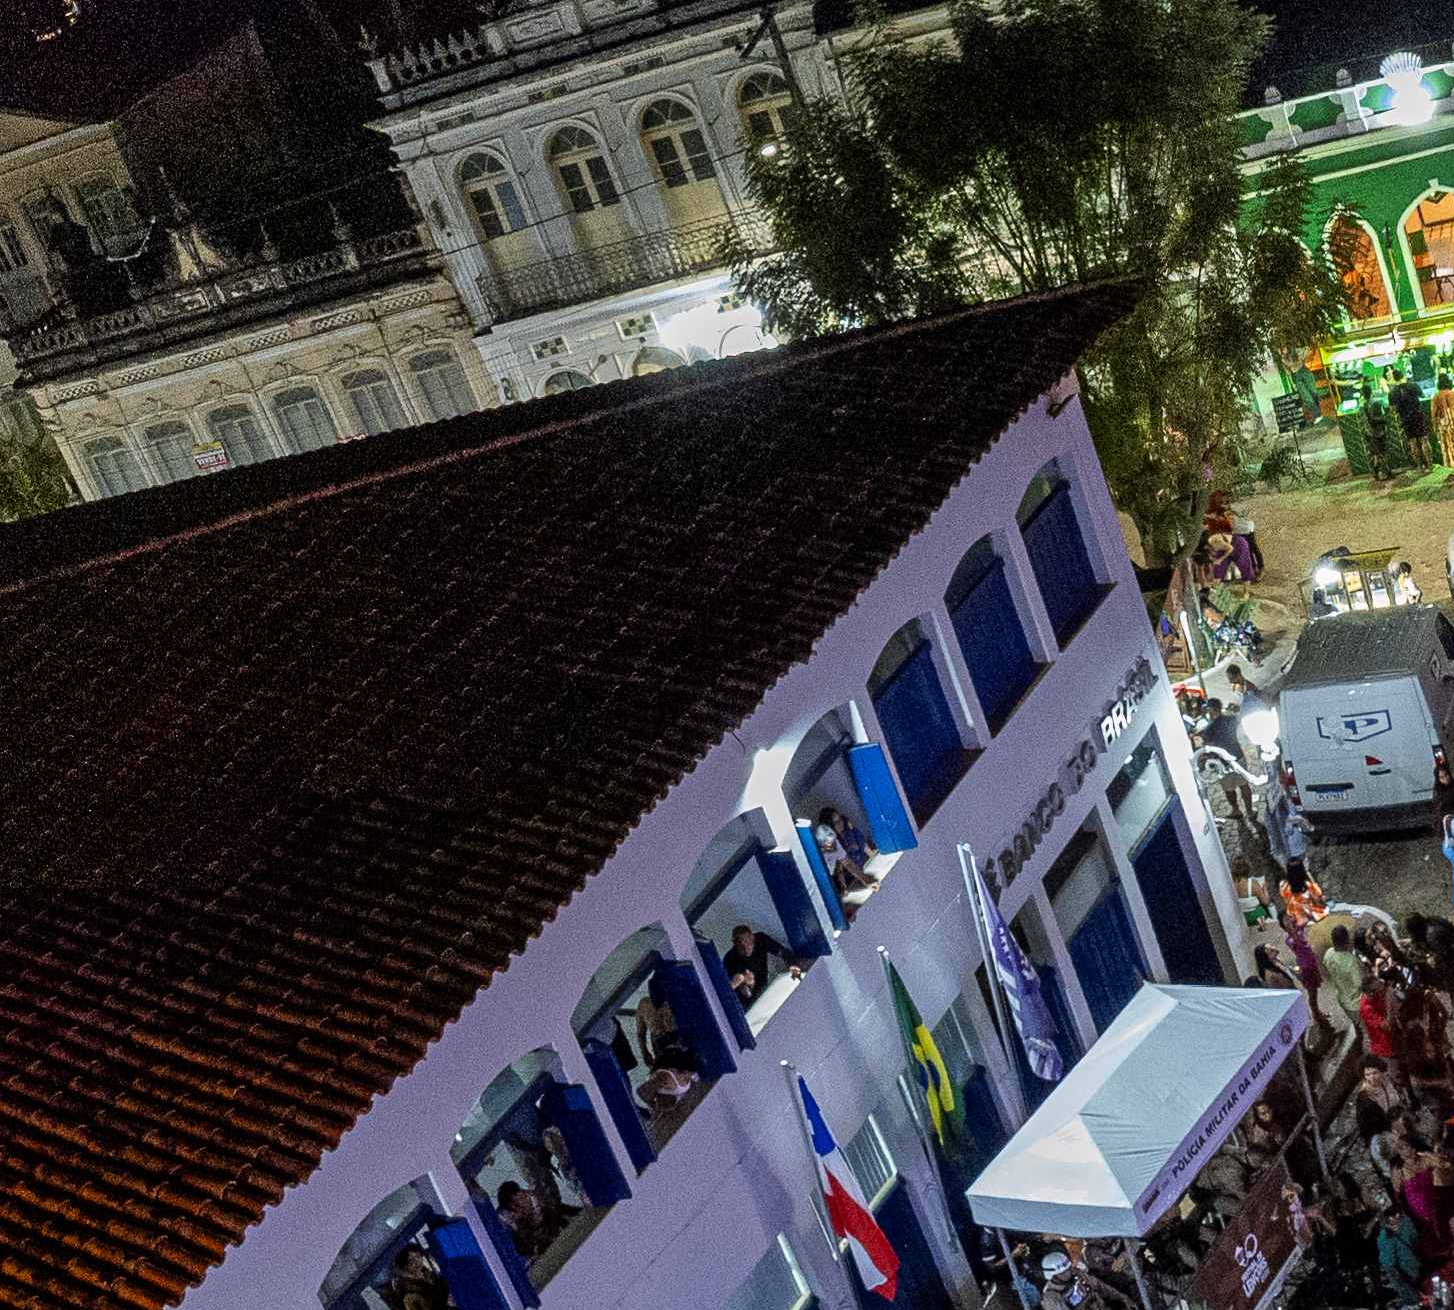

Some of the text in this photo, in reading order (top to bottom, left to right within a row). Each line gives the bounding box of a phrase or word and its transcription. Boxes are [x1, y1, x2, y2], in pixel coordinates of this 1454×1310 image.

[997, 782, 1065, 888] BANCO
[1205, 1092, 1239, 1137] MILITAR
[1250, 1046, 1277, 1079] BAHIA
